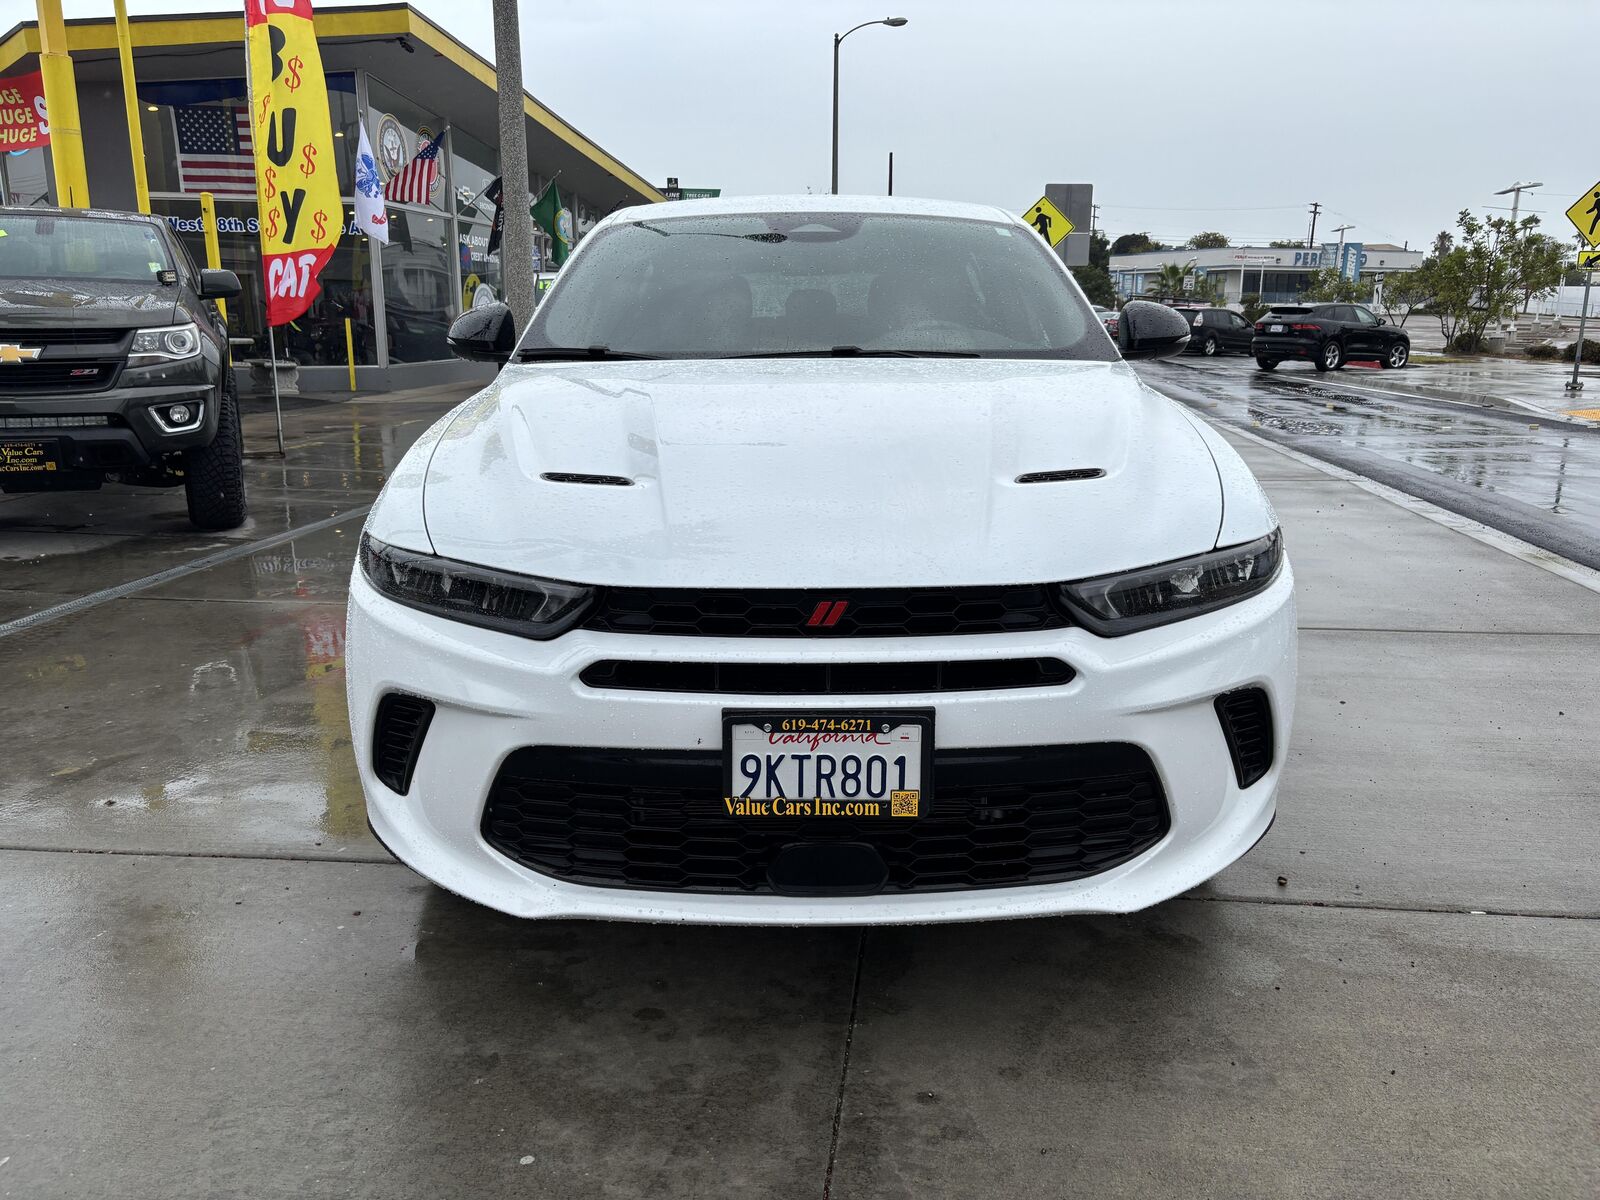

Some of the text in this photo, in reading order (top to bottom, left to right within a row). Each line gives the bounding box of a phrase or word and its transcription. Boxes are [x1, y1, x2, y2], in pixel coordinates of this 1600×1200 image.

[0, 88, 24, 105] GE
[217, 216, 246, 232] 8th
[1, 447, 44, 456] Value Cars
[781, 719, 872, 731] 619-474-6271
[768, 732, 891, 751] California
[739, 754, 907, 799] 9KTR801
[724, 797, 880, 816] Value Cars Inc.com
